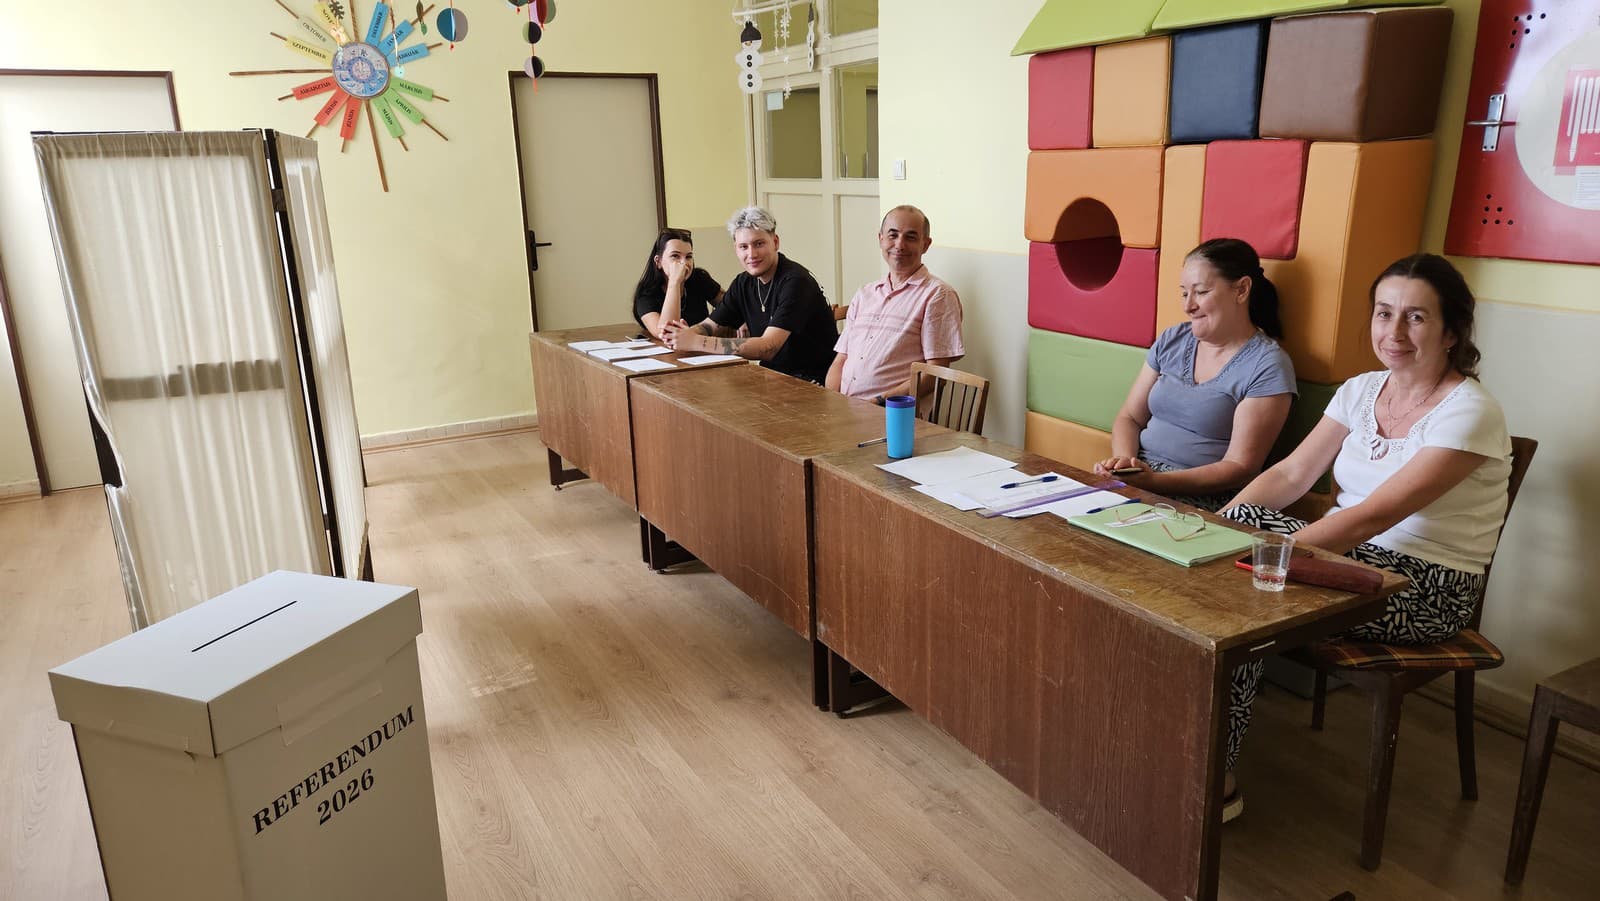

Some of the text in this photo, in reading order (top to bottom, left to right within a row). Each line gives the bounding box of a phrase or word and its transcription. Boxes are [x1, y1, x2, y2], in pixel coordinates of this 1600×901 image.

[292, 41, 327, 59] SZEPTEMBER
[299, 81, 331, 96] AUGUSZTUS
[252, 705, 415, 835] REFERENDUM
[317, 768, 375, 826] 2026
